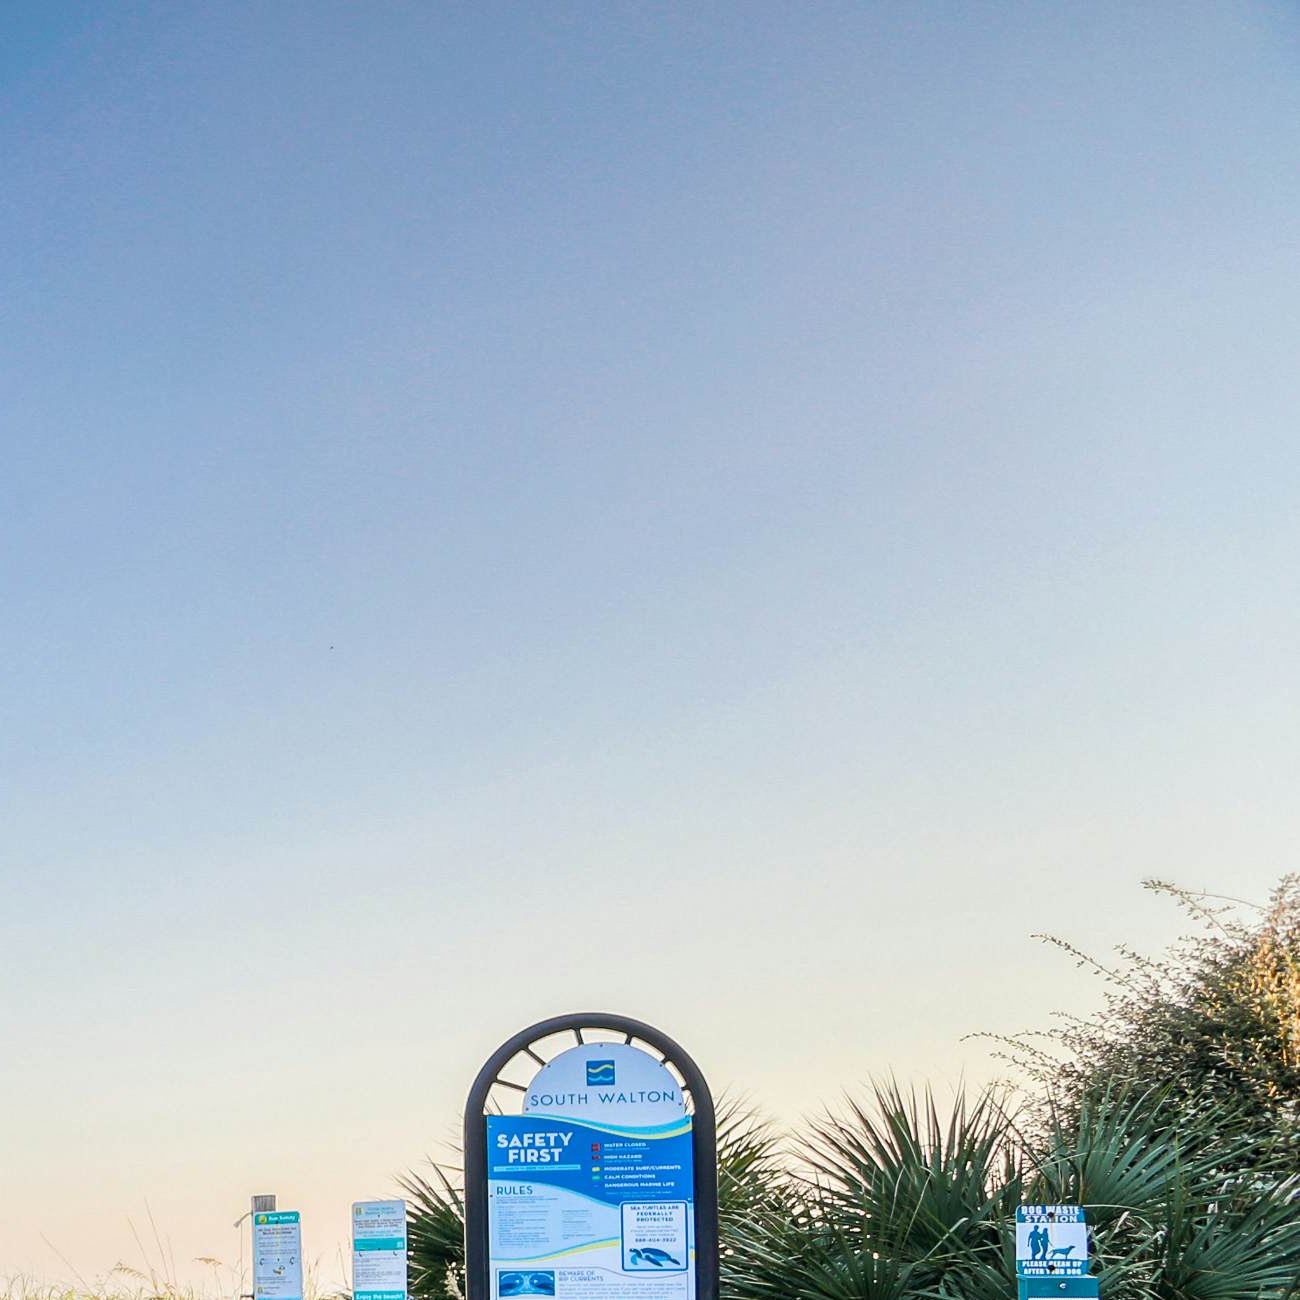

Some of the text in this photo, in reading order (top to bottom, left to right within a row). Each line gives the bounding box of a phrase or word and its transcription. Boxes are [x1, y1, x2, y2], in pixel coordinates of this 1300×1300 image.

[530, 1091, 675, 1107] SOUTH WALTON
[496, 1132, 574, 1148] SAFETY
[508, 1147, 563, 1163] FIRST
[496, 1185, 533, 1195] RULES
[1020, 1205, 1080, 1214] DOG WASTE
